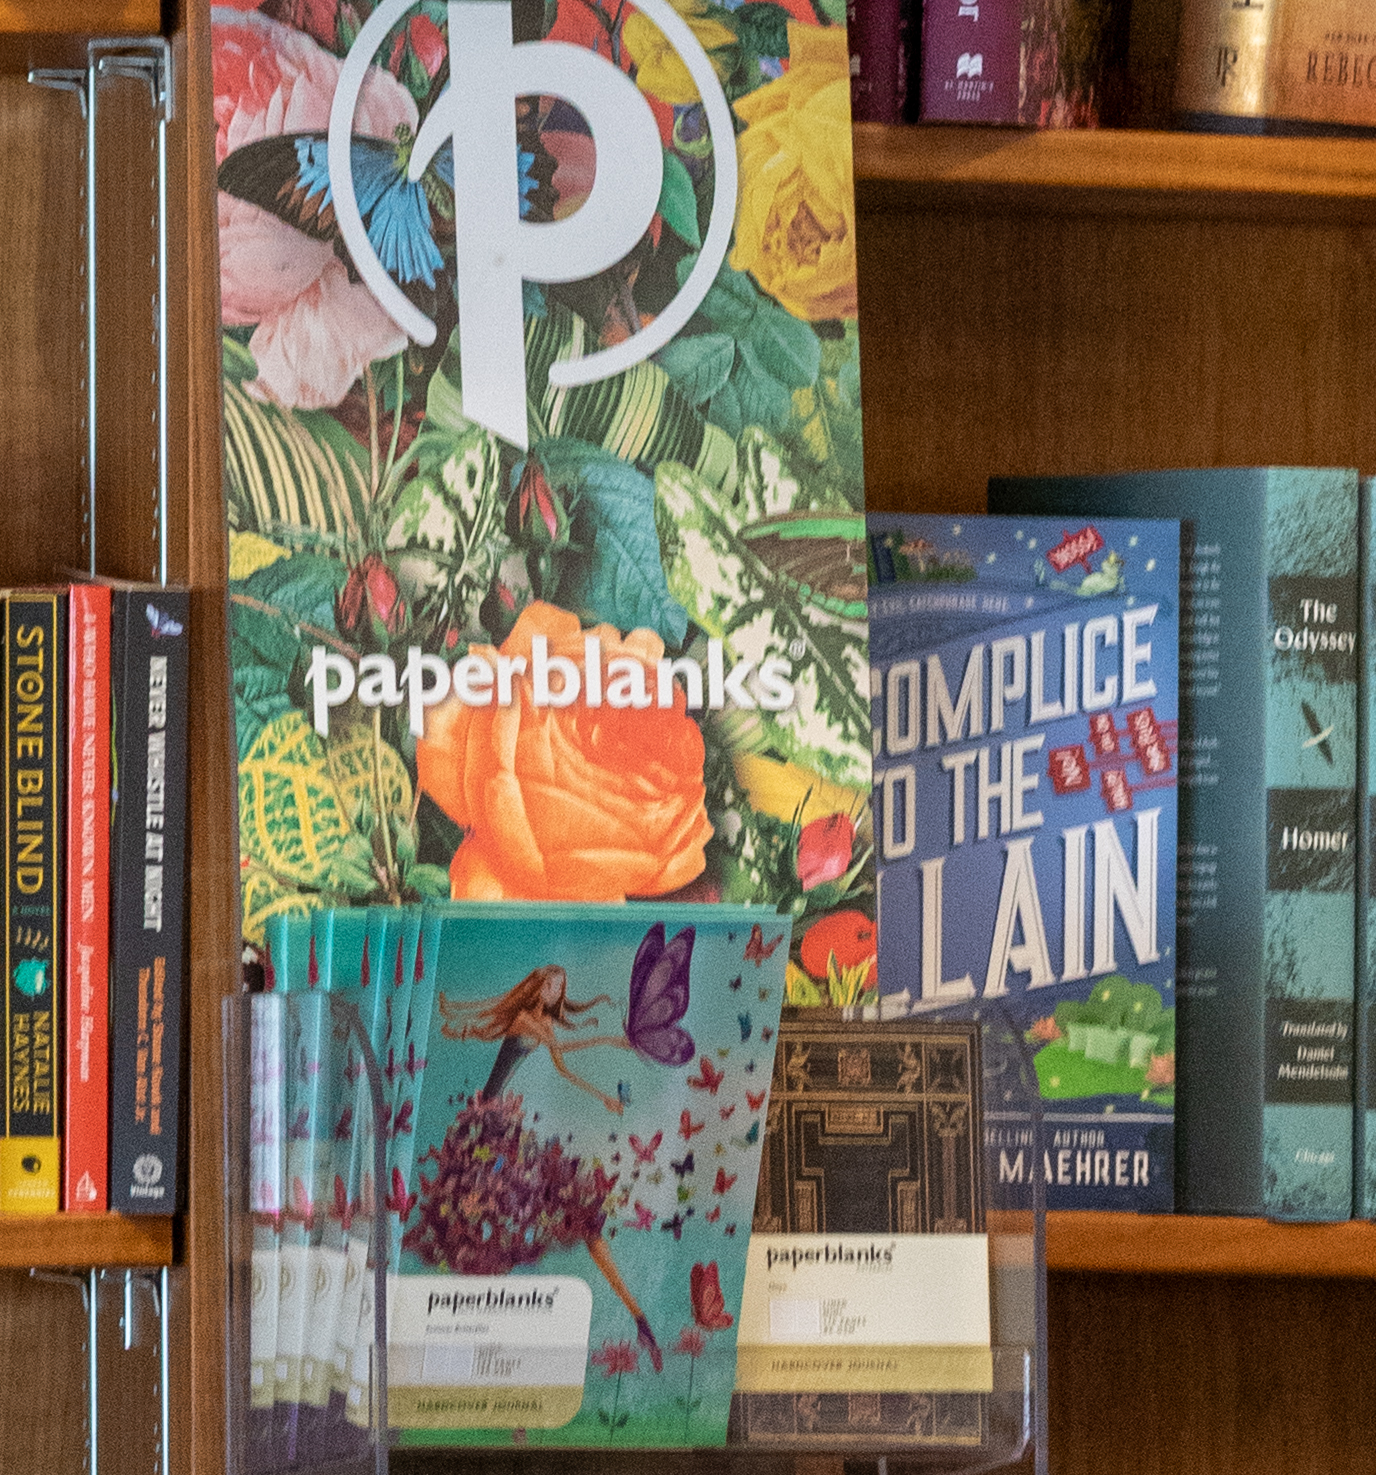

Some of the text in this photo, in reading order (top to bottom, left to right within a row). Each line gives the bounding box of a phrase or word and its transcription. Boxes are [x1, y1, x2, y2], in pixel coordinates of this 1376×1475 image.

[1300, 600, 1337, 624] The
[1274, 627, 1356, 655] Odyssey
[15, 624, 45, 896] STONE BLIND
[1282, 827, 1348, 853] Homer
[12, 1012, 31, 1113] HAYNES
[32, 1011, 50, 1116] NATALIE
[766, 1243, 894, 1272] paperblanks
[427, 1289, 557, 1314] paperblanks
